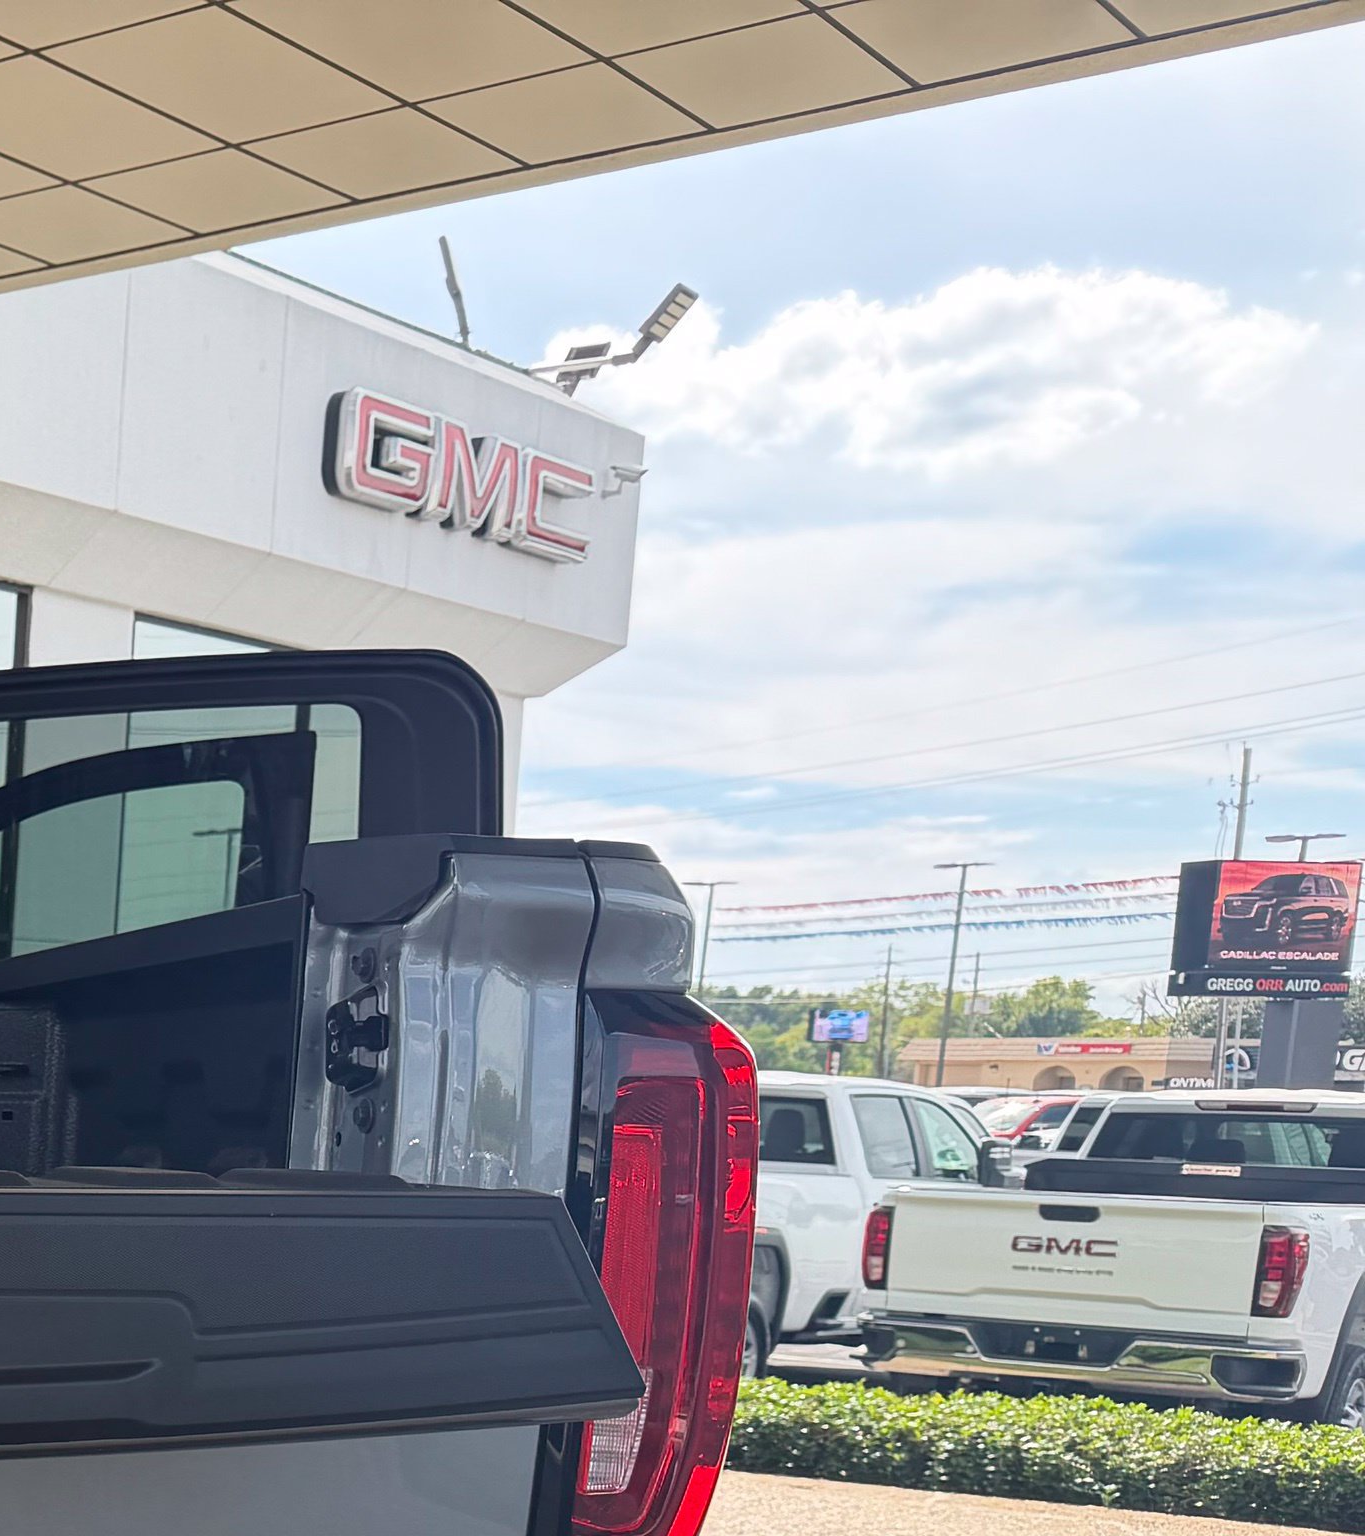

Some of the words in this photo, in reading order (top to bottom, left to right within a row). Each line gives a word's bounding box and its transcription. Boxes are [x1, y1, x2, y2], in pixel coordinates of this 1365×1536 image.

[321, 386, 596, 562] GMC
[1219, 950, 1277, 960] CADILLAC
[1277, 951, 1340, 961] ESCALADE
[1206, 977, 1254, 991] GREGG
[1255, 979, 1284, 991] ORR
[1285, 979, 1349, 993] AUTO.com
[1011, 1235, 1119, 1258] GMC
